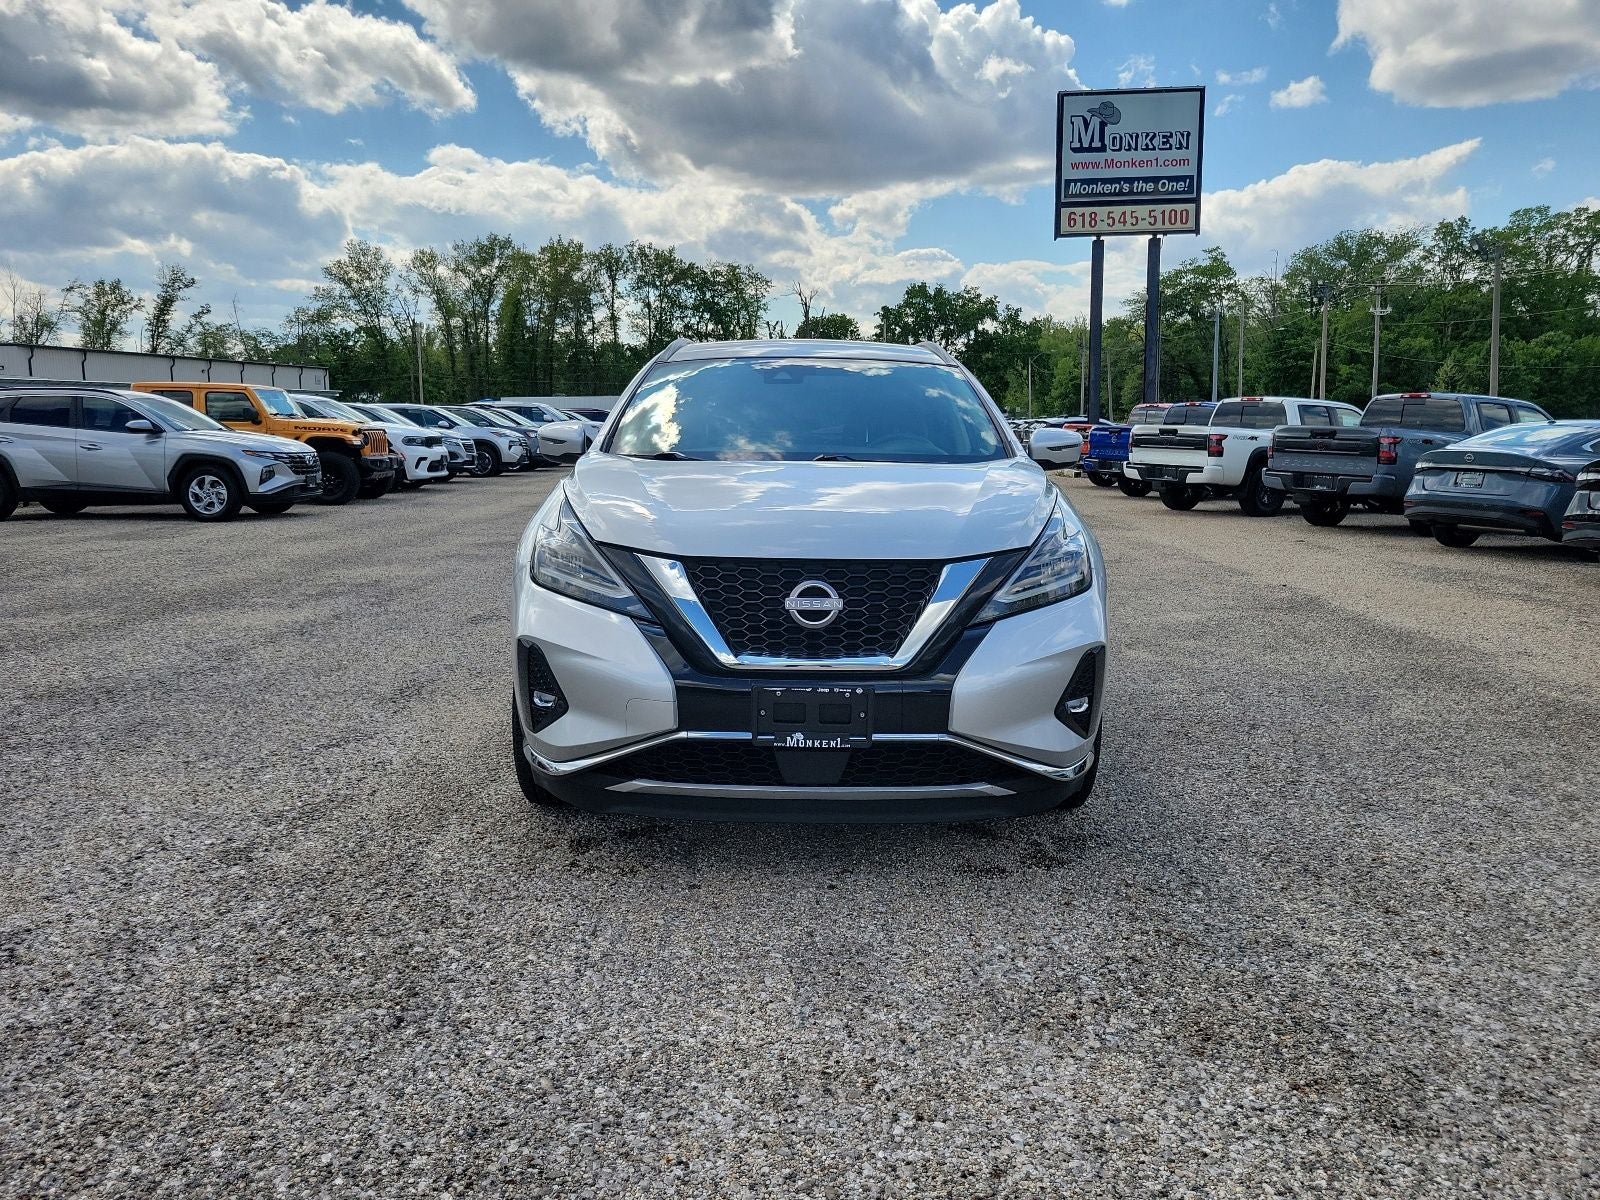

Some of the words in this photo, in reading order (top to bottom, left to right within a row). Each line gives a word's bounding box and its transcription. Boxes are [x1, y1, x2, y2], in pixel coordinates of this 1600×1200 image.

[1070, 114, 1191, 153] MONKEN
[1070, 157, 1190, 170] www.Monken1.com
[1068, 181, 1130, 195] Monken's
[1133, 180, 1155, 192] the
[1158, 179, 1190, 192] One!
[1067, 208, 1190, 228] 618-545-5100
[294, 425, 348, 433] MOJAVE
[786, 600, 842, 608] NISSAN
